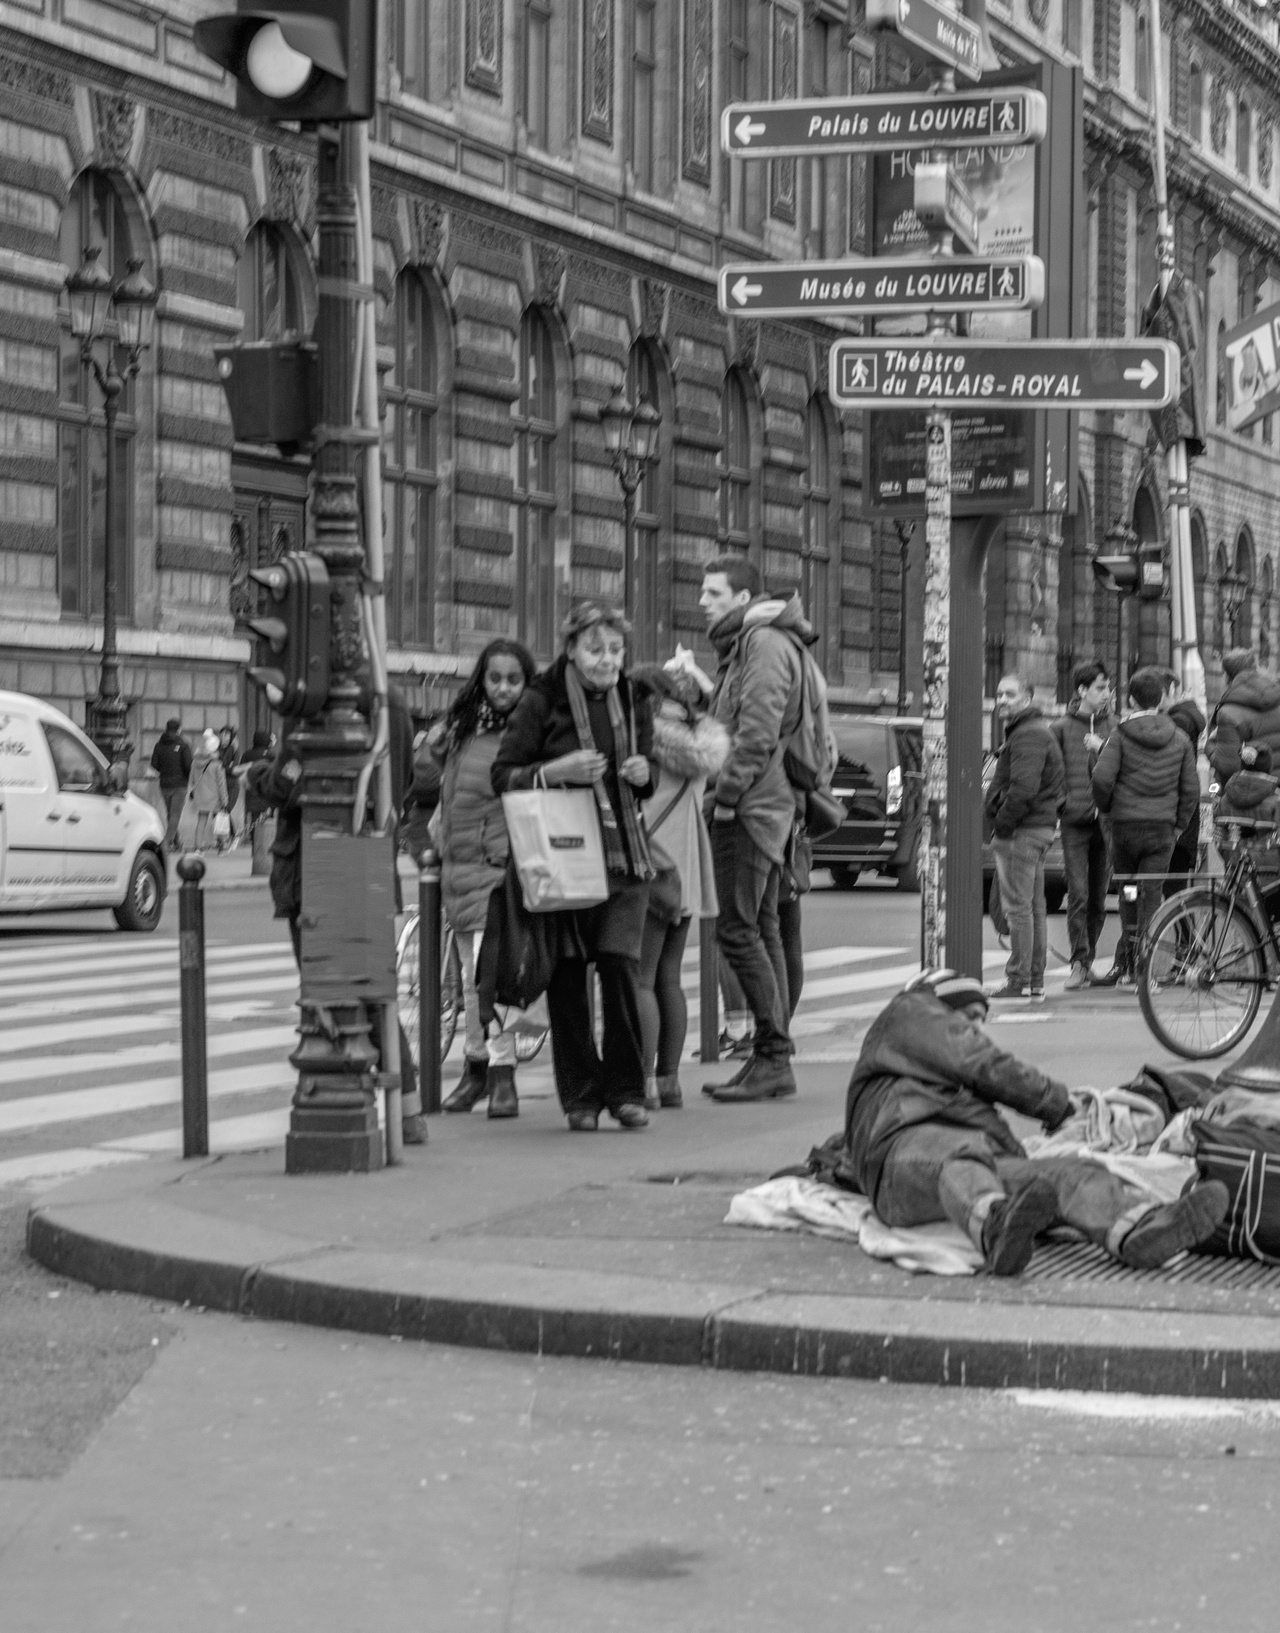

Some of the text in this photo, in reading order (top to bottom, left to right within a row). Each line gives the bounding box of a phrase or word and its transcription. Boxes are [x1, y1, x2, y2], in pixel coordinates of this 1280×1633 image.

[808, 106, 989, 138] Palais du LOUVRE
[800, 272, 987, 300] Musée du LOUVRE
[884, 350, 965, 373] Théâtre
[882, 373, 1082, 397] du PALAIS-ROYAL
